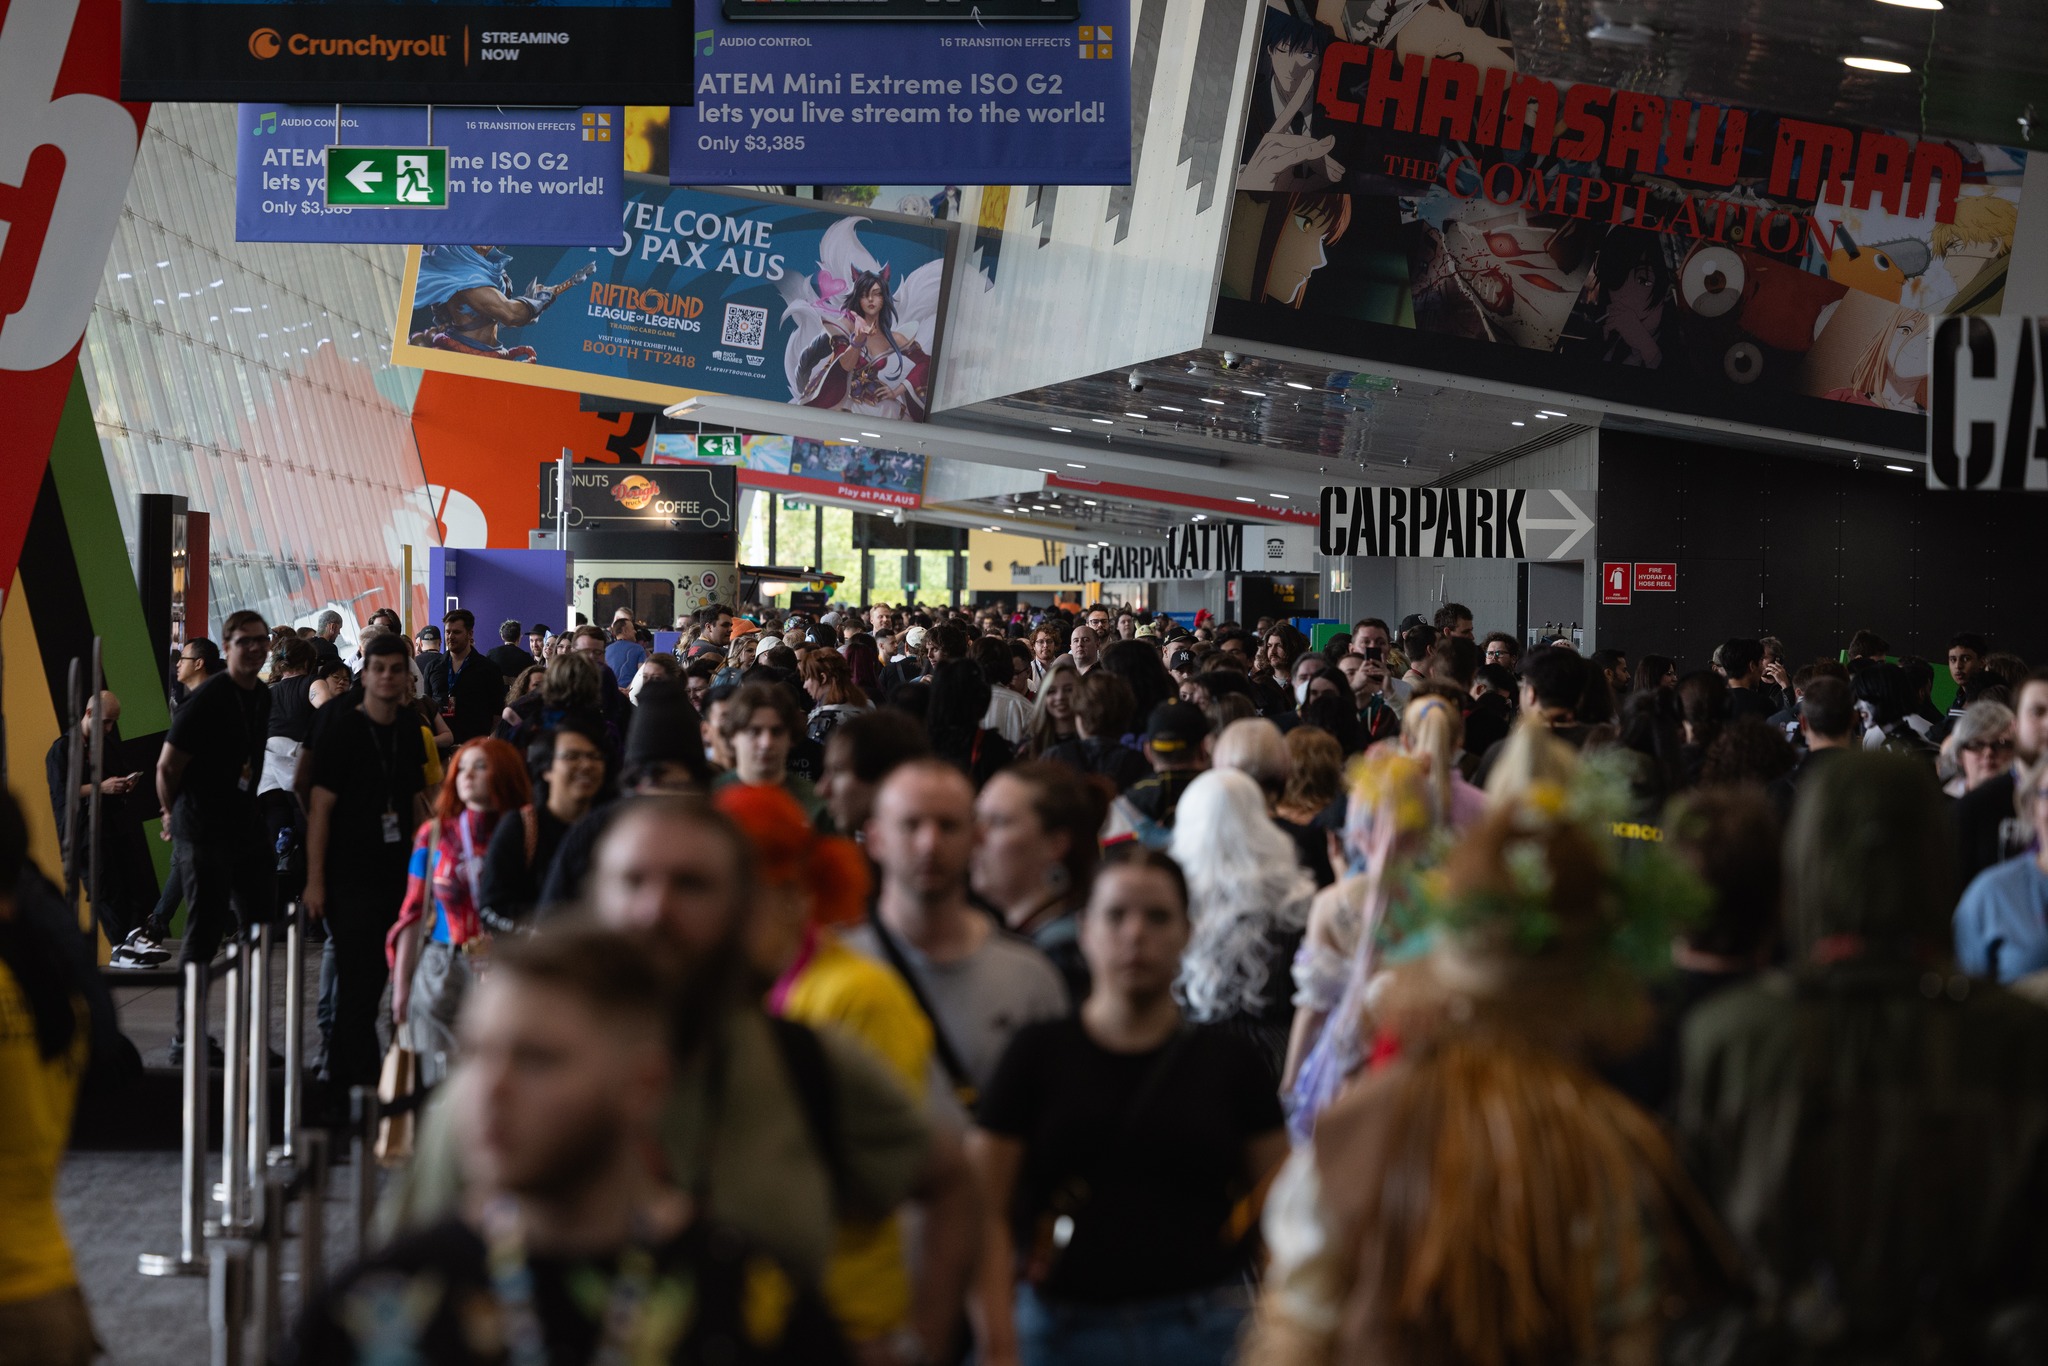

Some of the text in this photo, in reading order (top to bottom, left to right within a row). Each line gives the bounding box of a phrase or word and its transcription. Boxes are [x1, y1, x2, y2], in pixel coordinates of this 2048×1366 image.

[288, 33, 447, 62] Crunchyroll
[481, 32, 570, 44] STREAMING
[719, 37, 813, 47] AUDIO CONTROL
[940, 37, 1071, 48] 16 TRANSITION EFFECTS
[481, 49, 519, 61] NOW
[697, 72, 1063, 95] ATEM Mini Extreme ISO G2
[281, 118, 312, 127] AUDIO
[699, 102, 1105, 129] lets you live stream to the world!
[466, 121, 576, 131] 16 TRANSITION EFFECTS
[1316, 41, 1963, 225] CHAINSAW MAN
[698, 135, 805, 153] Only $3,385
[262, 148, 326, 167] ATEM
[491, 152, 531, 170] ISO
[537, 153, 569, 171] G2
[263, 171, 325, 196] lets yo
[472, 177, 493, 193] to
[499, 175, 532, 193] the
[538, 176, 604, 195] world!
[262, 200, 297, 216] Only
[1383, 153, 1844, 265] THE COMPILATION
[641, 234, 710, 270] PAX
[715, 247, 785, 281] AUS
[589, 281, 704, 319] RIFTBOUND
[587, 304, 636, 323] LEAGUE
[644, 314, 701, 333] LEGENDS
[609, 322, 676, 338] TRADING CARD GAME
[598, 334, 614, 342] VISIT
[643, 341, 667, 351] EXHIBIT
[667, 345, 684, 353] HALL
[583, 339, 696, 368] BOOTH TT2418
[722, 356, 743, 364] GAMES
[705, 365, 767, 379] PLAYRIFTBOUND.COM
[572, 474, 609, 487] NUTS
[611, 480, 660, 502] Dough
[838, 486, 915, 505] Play at PAX AUS
[655, 500, 700, 514] COFFEE
[1320, 486, 1526, 558] CARPARK
[1100, 546, 1193, 578] CARPA
